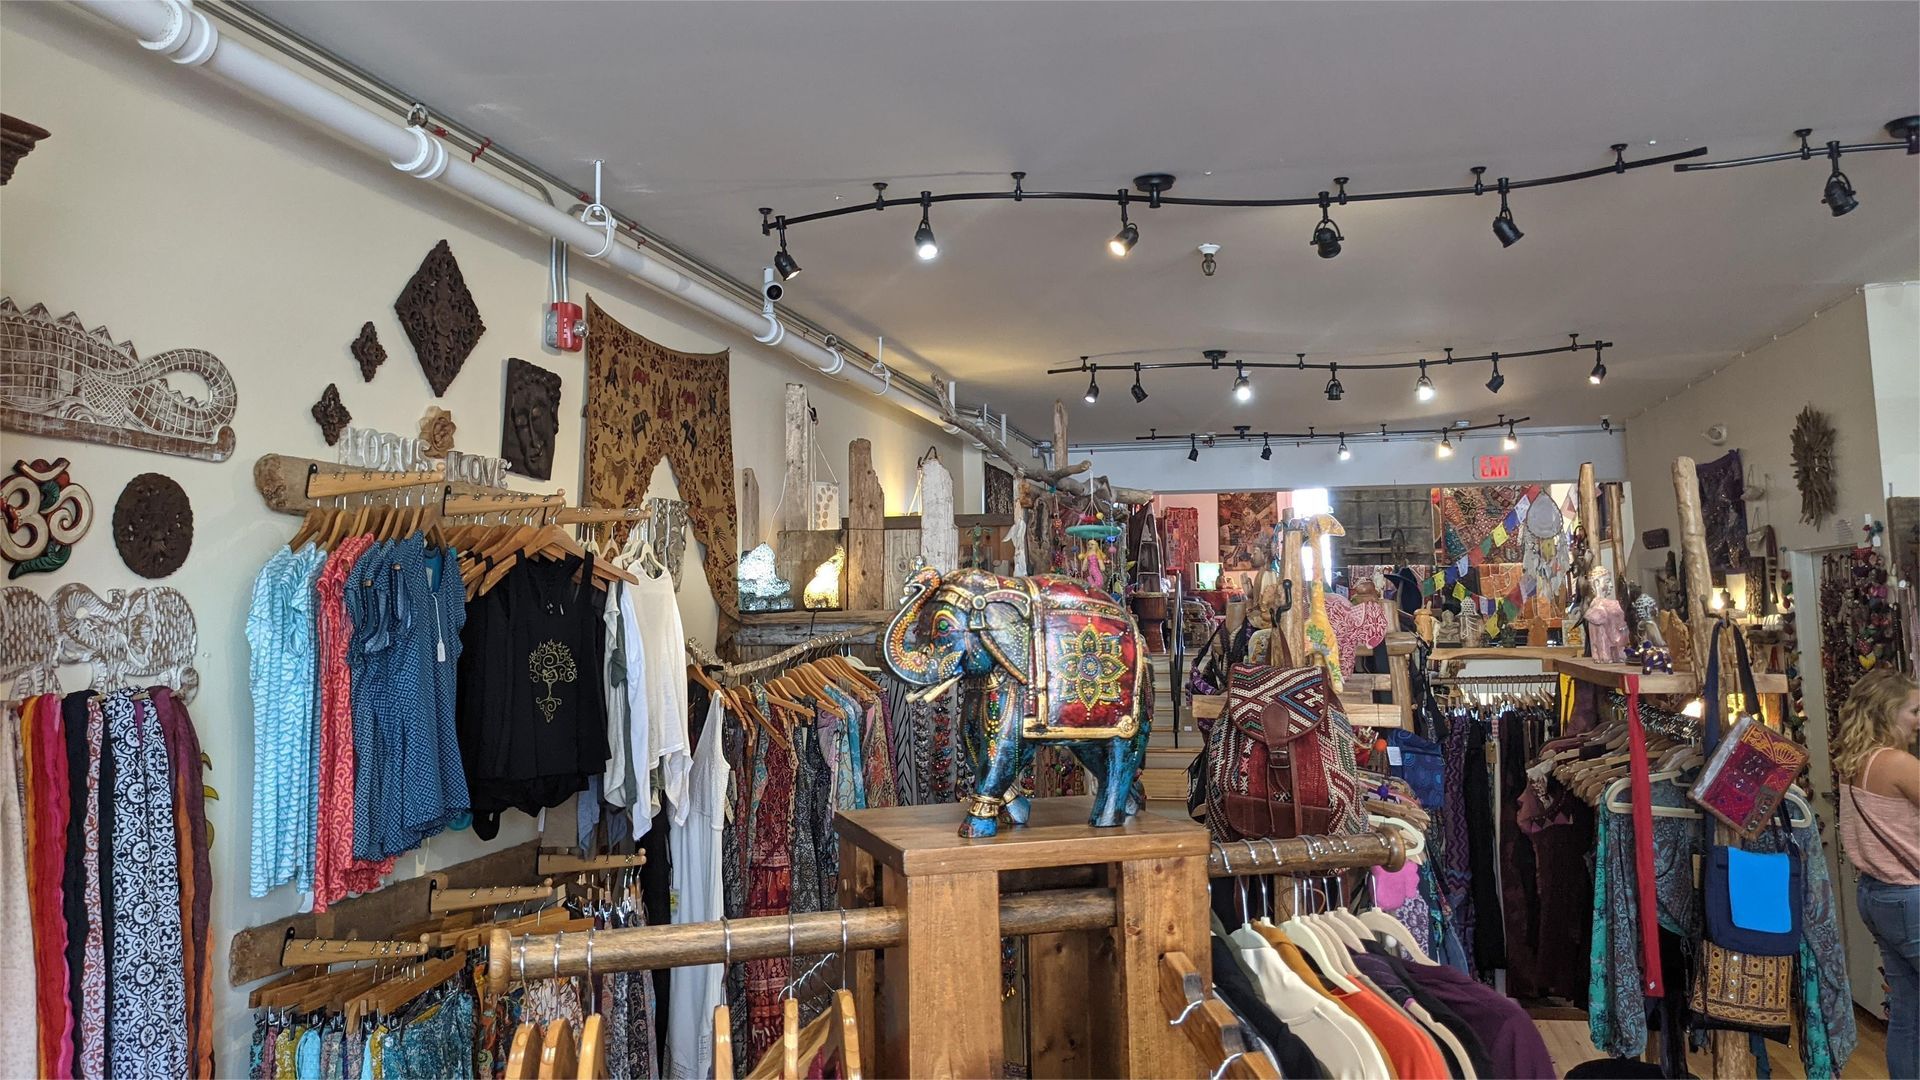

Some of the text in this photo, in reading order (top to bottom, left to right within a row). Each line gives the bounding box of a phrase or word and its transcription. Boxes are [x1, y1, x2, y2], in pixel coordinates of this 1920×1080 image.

[338, 427, 432, 472] LOTUS
[1480, 455, 1510, 477] EXIT
[447, 451, 508, 489] LOVE
